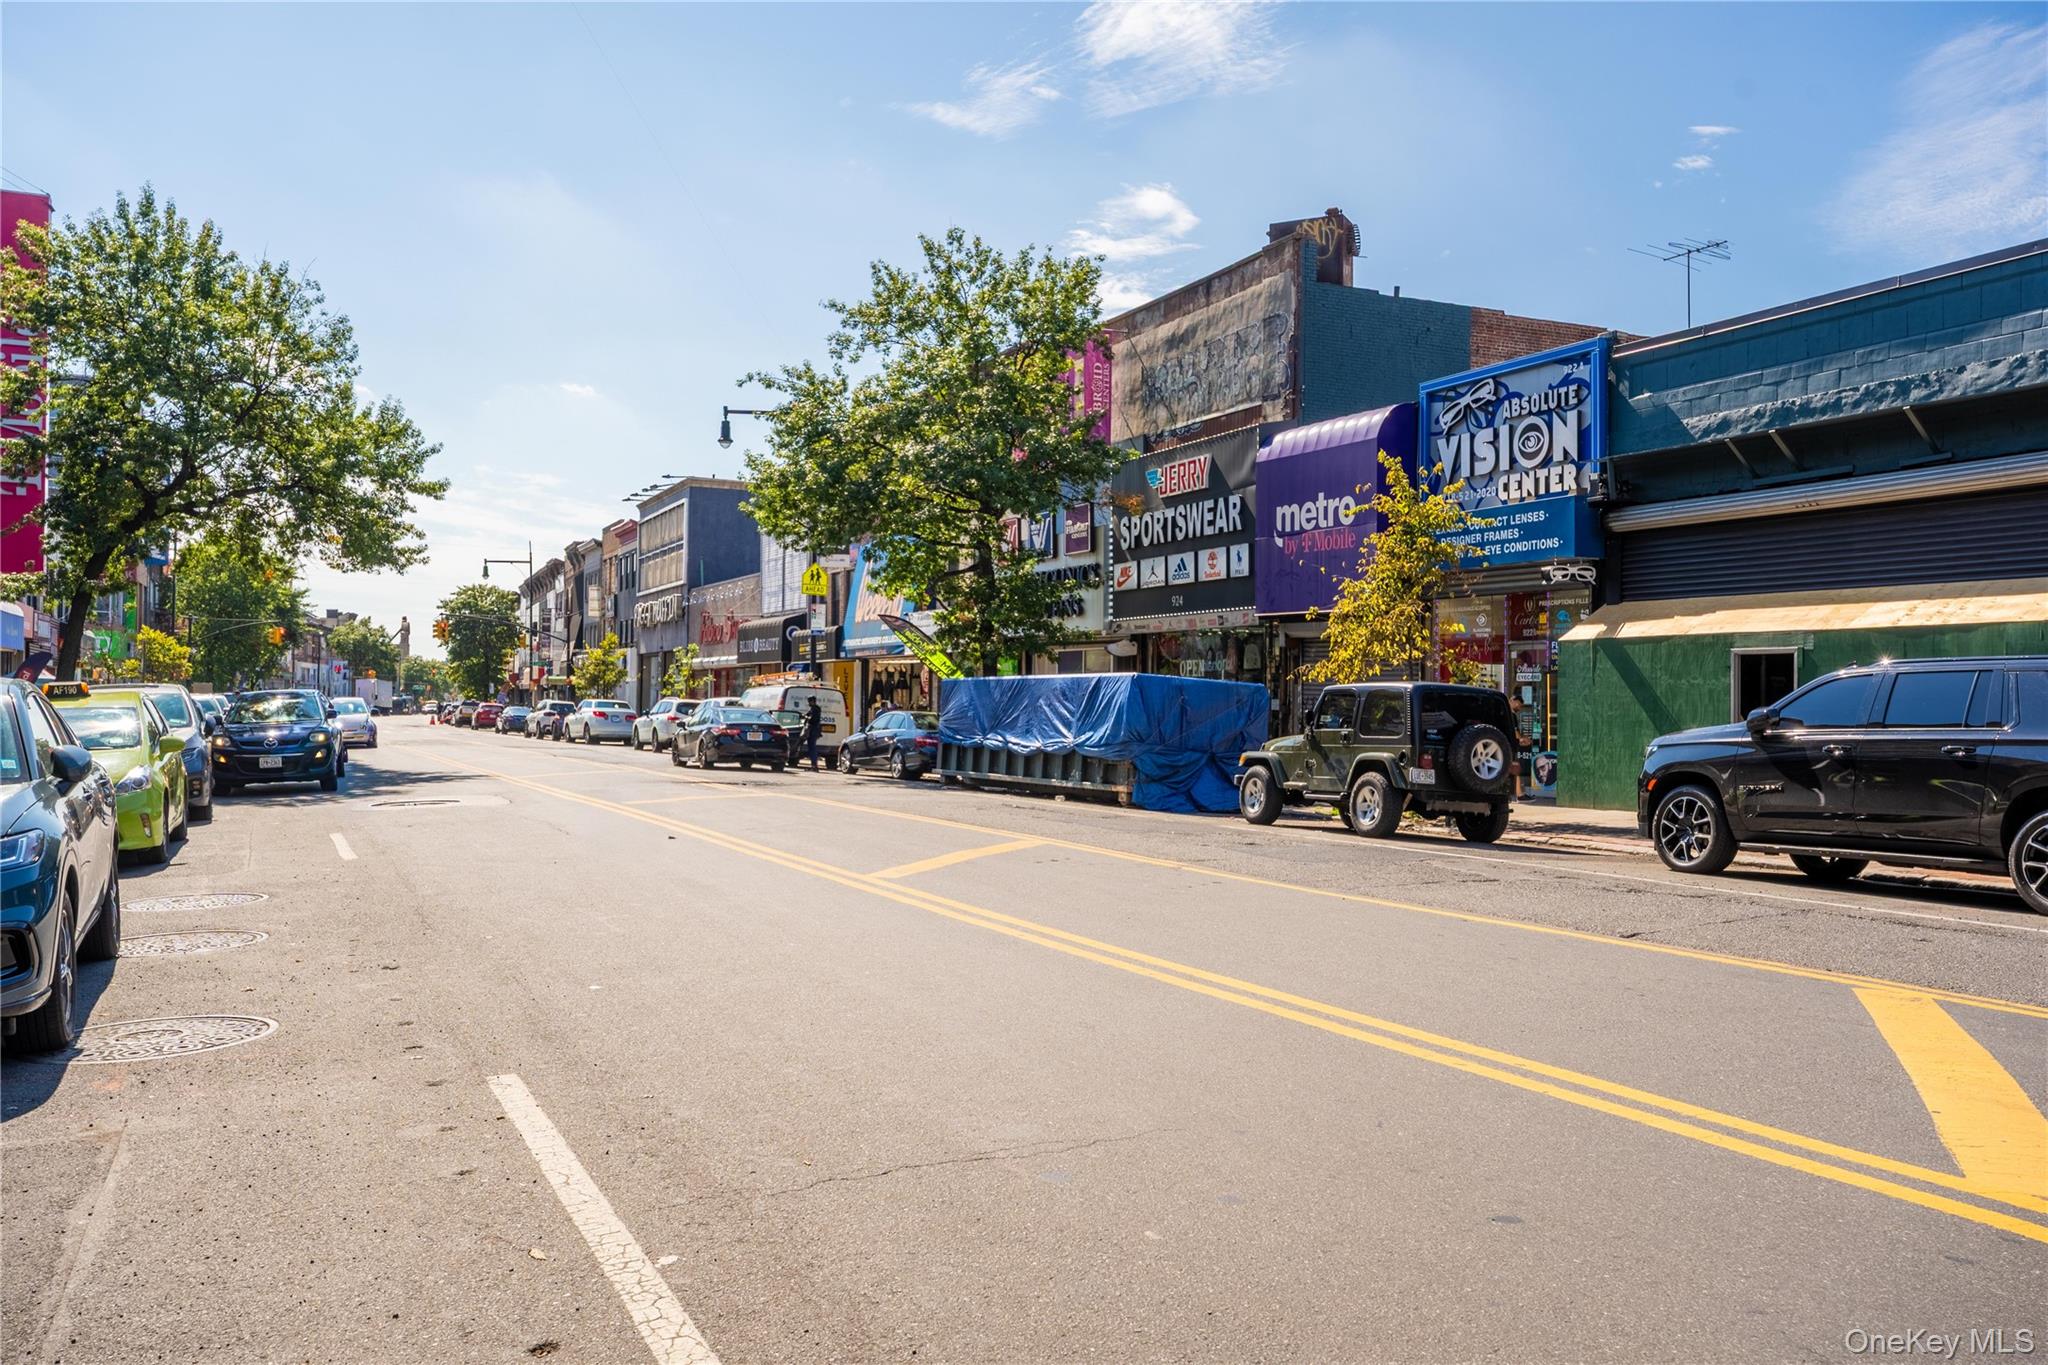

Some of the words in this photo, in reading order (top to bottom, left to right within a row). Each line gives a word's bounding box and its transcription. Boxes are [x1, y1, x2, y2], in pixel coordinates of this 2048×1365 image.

[1502, 383, 1579, 419] ABSOLUTE
[1438, 409, 1579, 484] VISION
[1159, 454, 1209, 497] JERRY
[1498, 463, 1577, 500] CENTER
[1276, 492, 1356, 532] metro
[1510, 510, 1545, 525] LENSES
[1120, 494, 1242, 550] SPORTSWEAR
[1285, 536, 1297, 559] by
[1314, 526, 1356, 552] Mobile
[1440, 534, 1482, 548] DESIGNER
[1484, 528, 1519, 542] FRAMES
[1485, 544, 1502, 556] EYE
[1503, 537, 1560, 553] CONDITIONS
[1120, 565, 1132, 576] NIKE
[1172, 572, 1191, 581] adidas
[805, 585, 824, 594] AHEAD
[1171, 595, 1184, 607] 924
[1180, 659, 1204, 677] OPEN
[53, 686, 78, 694] AF190
